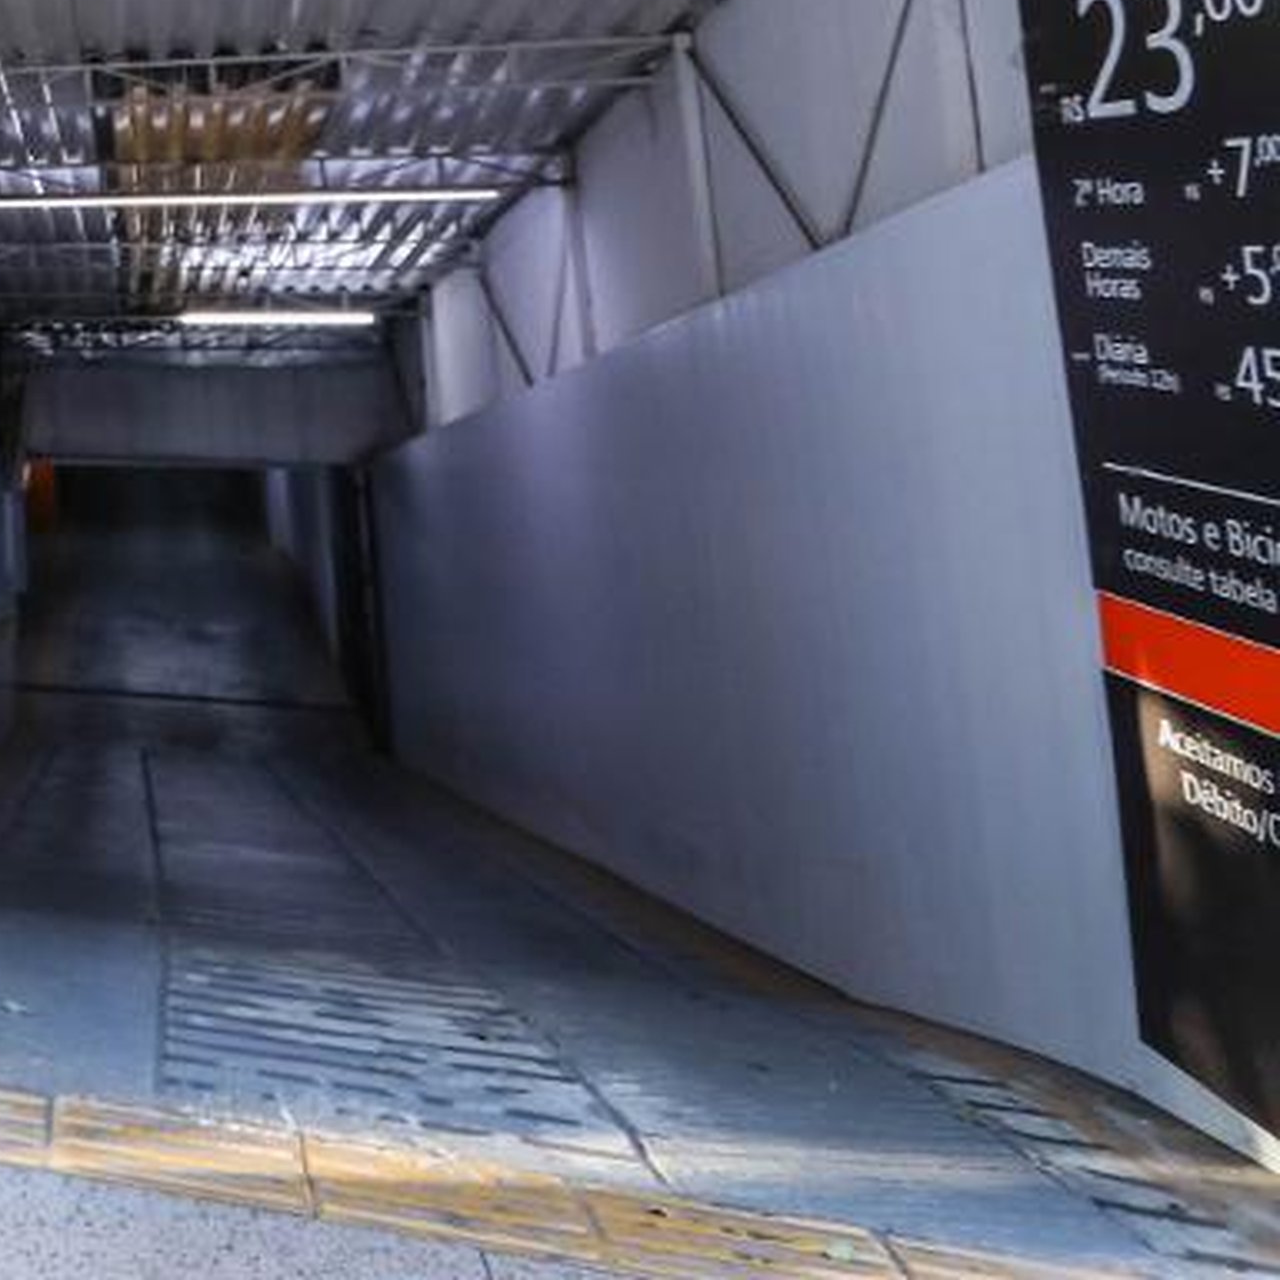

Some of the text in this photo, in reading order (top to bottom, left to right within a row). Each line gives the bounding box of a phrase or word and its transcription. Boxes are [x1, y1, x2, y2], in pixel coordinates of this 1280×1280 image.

[1096, 177, 1145, 205] Hora
[1086, 270, 1142, 300] Horas
[1118, 492, 1197, 545] Motos
[1203, 521, 1221, 552] e
[1123, 548, 1277, 614] consulte tabela
[1159, 718, 1276, 795] Aceitamos
